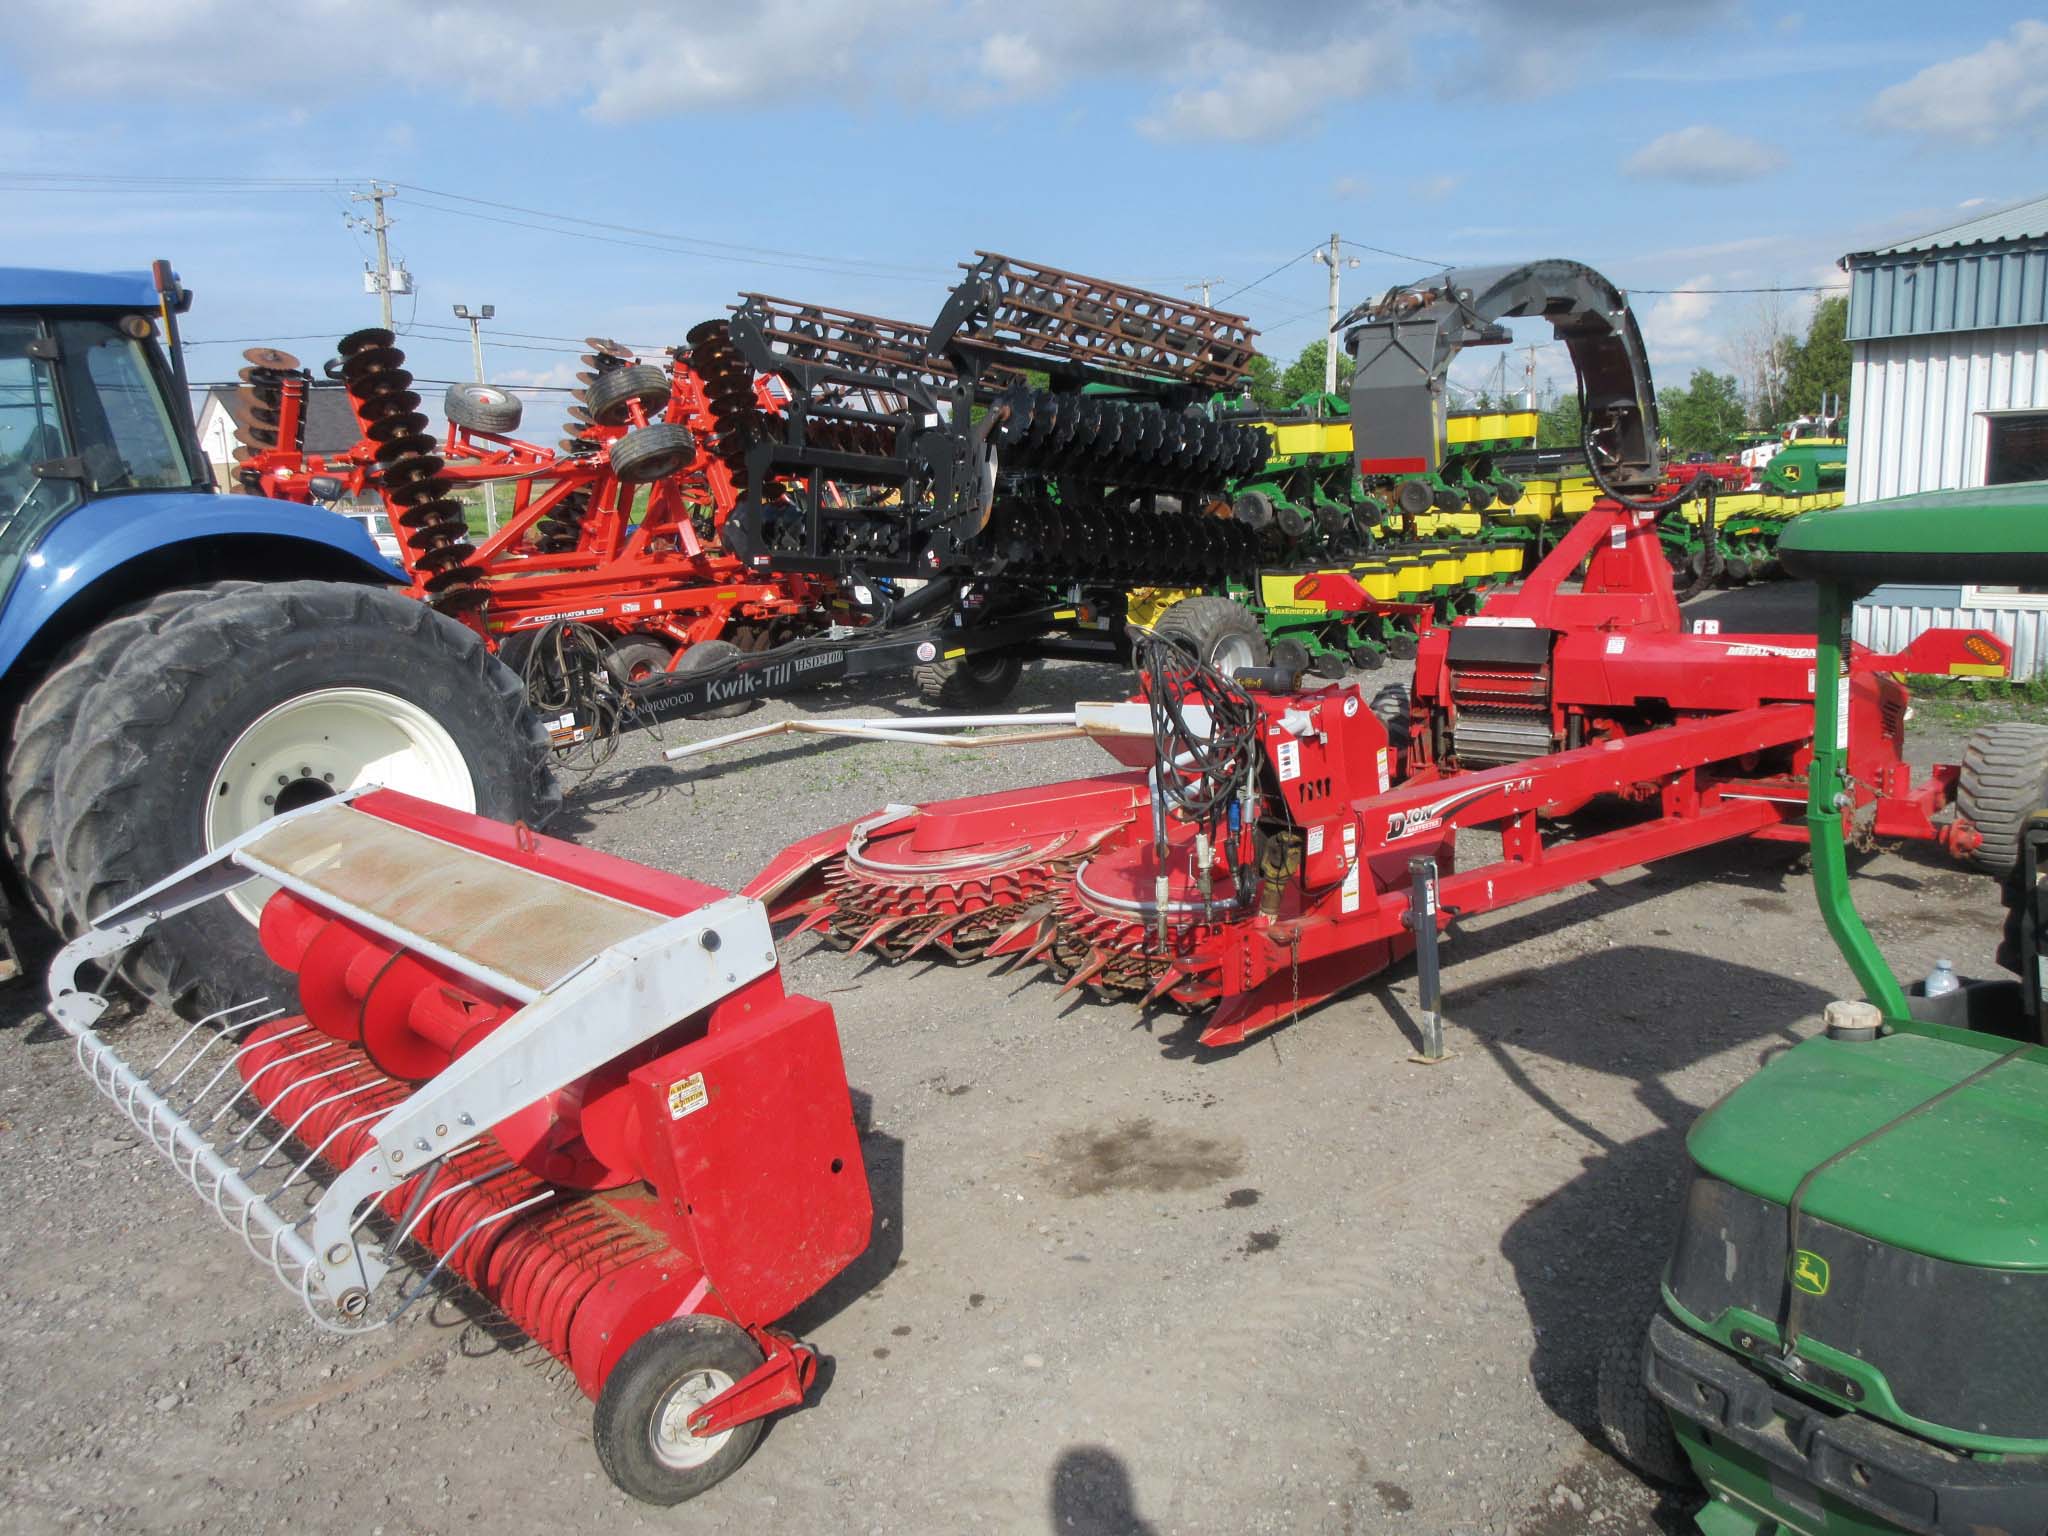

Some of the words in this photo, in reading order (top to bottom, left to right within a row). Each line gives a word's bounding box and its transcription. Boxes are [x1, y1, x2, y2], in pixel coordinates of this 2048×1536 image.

[706, 660, 792, 703] Kwik-Till
[636, 692, 694, 715] NORWOOD
[1504, 777, 1533, 797] F-41
